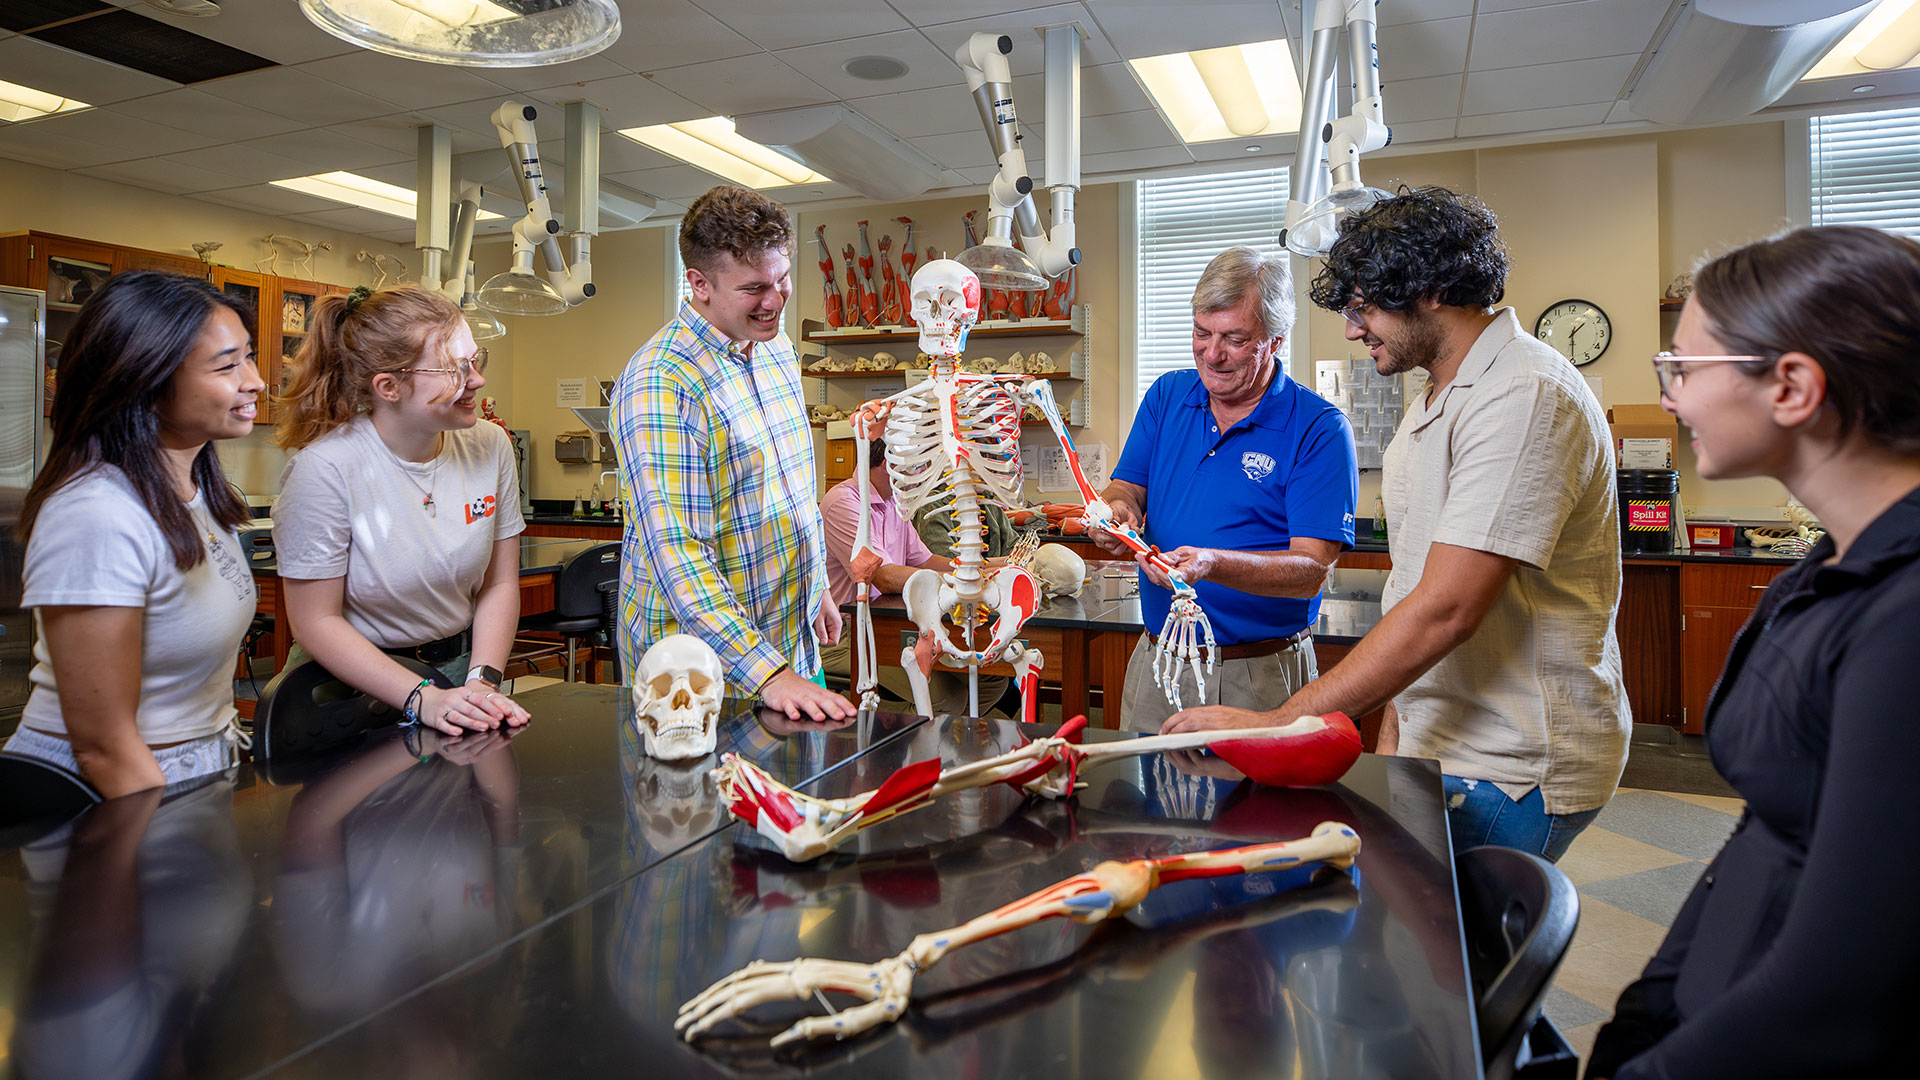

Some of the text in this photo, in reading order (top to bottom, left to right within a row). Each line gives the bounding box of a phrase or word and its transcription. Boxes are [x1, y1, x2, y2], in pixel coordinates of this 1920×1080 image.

[1596, 316, 1602, 324] 2
[1540, 331, 1547, 339] 9
[1599, 330, 1605, 338] 3
[1595, 342, 1600, 350] 4
[1570, 357, 1576, 365] 6
[1584, 353, 1591, 361] 5
[1242, 452, 1276, 472] CNU
[1633, 511, 1667, 520] Spill Kit
